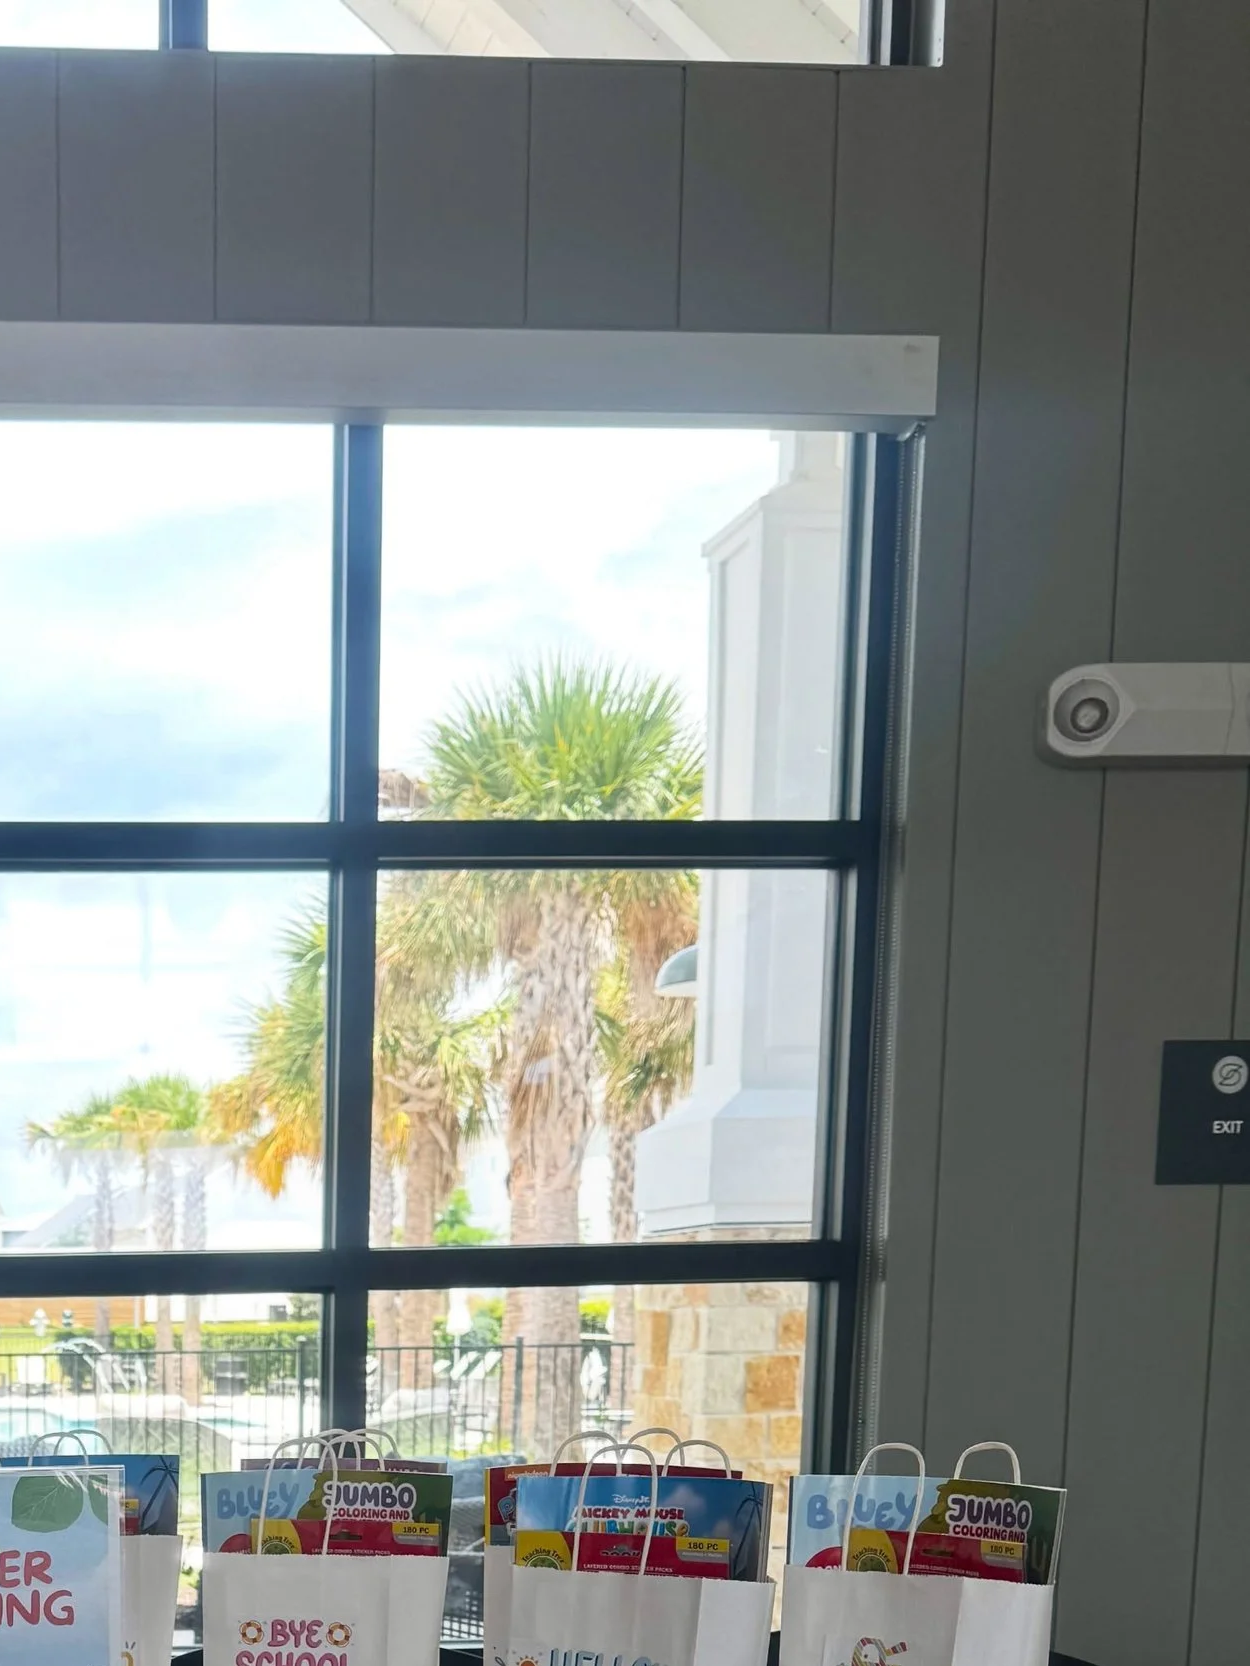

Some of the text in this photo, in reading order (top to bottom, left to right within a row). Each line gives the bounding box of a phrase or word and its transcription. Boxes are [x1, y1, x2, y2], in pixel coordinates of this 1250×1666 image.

[1212, 1119, 1244, 1134] EXIT
[216, 1482, 300, 1520] BLUEY
[325, 1484, 414, 1509] JUMBO
[389, 1510, 410, 1520] AND
[575, 1507, 631, 1519] MICKEY
[807, 1491, 918, 1530] BLUEY
[948, 1497, 1031, 1530] JUMBO
[403, 1525, 430, 1535] 180 PC
[952, 1524, 1026, 1543] COLORING AND
[687, 1541, 719, 1551] 180 PC
[990, 1545, 1015, 1555] 180 PC
[266, 1618, 324, 1648] BYE
